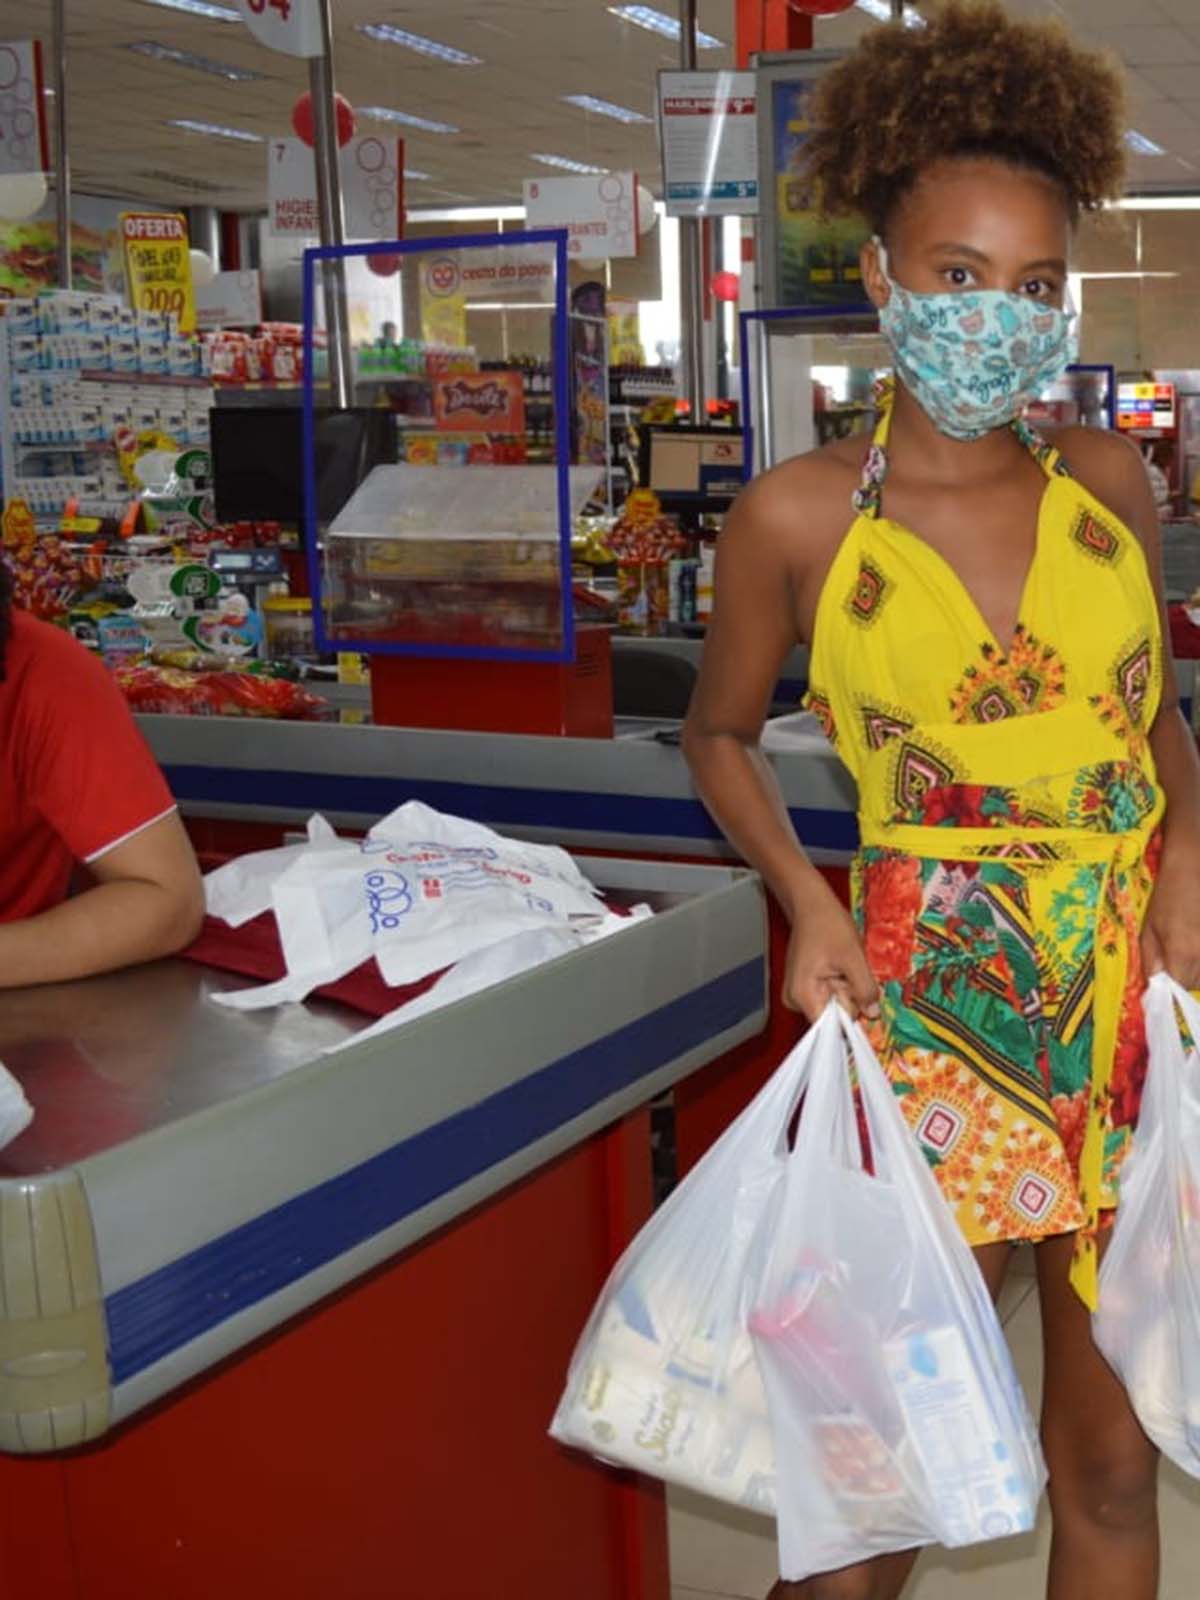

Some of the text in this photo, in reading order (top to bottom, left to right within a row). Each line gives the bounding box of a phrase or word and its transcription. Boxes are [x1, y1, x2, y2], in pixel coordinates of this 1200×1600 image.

[275, 200, 318, 214] HIGIE
[125, 218, 184, 238] OFERTA
[275, 215, 320, 230] INFANT
